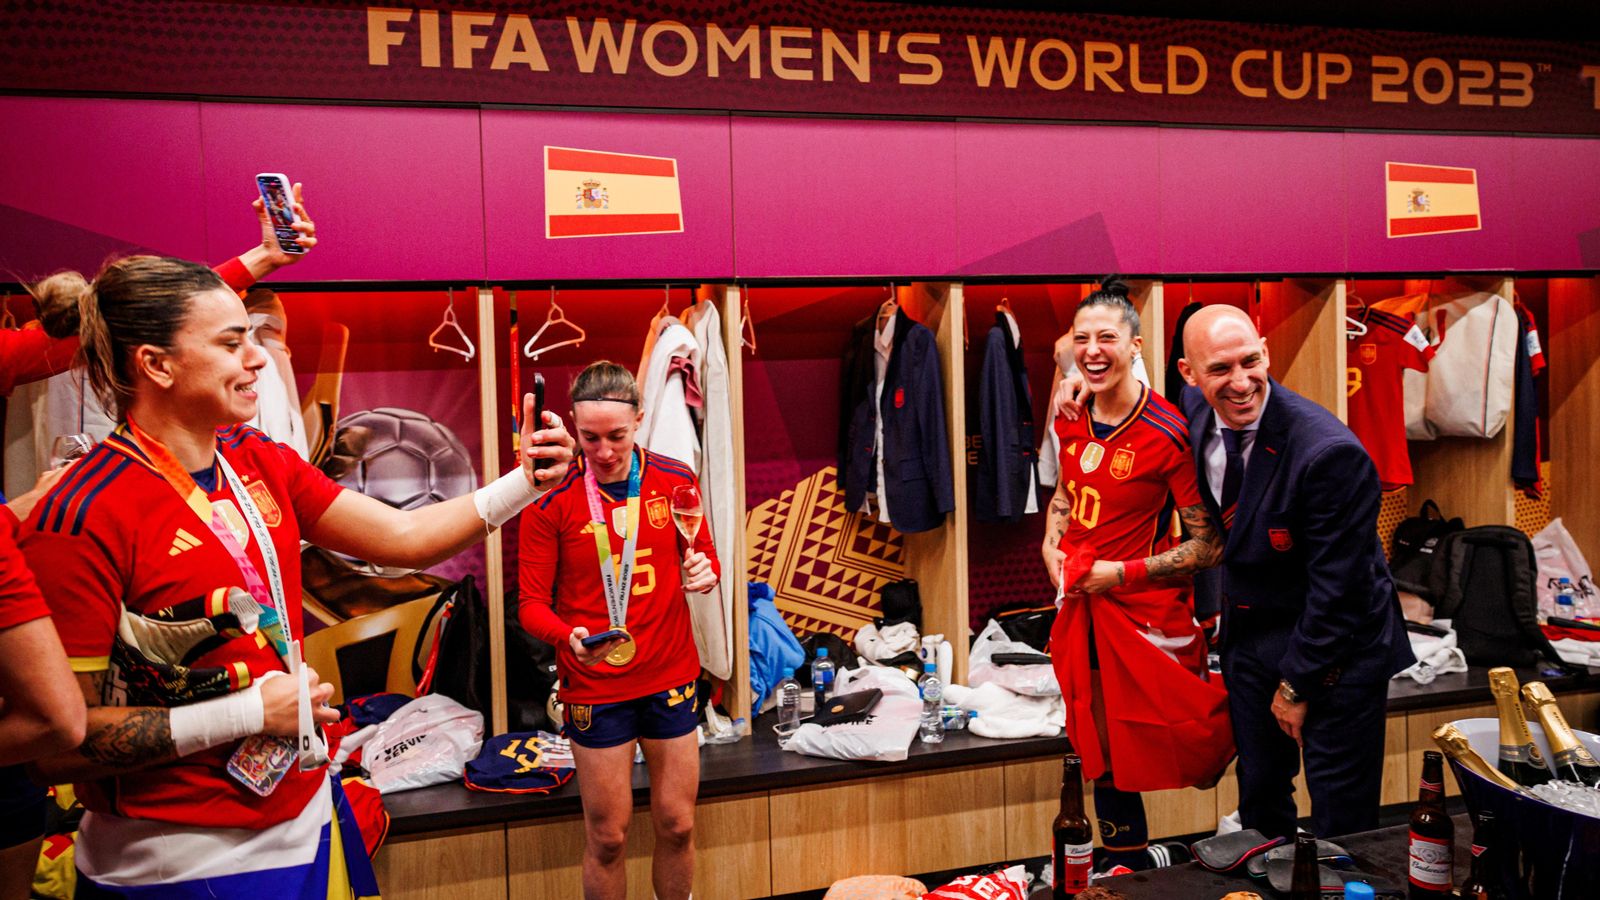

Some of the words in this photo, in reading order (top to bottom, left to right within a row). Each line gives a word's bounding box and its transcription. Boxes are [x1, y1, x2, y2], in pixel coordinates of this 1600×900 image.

[366, 7, 549, 72] FIFA
[566, 16, 943, 85] WOMEN'S
[967, 35, 1208, 95] WORLD
[1232, 49, 1352, 100] CUP
[1371, 56, 1535, 108] 2023
[1067, 480, 1101, 529] 10
